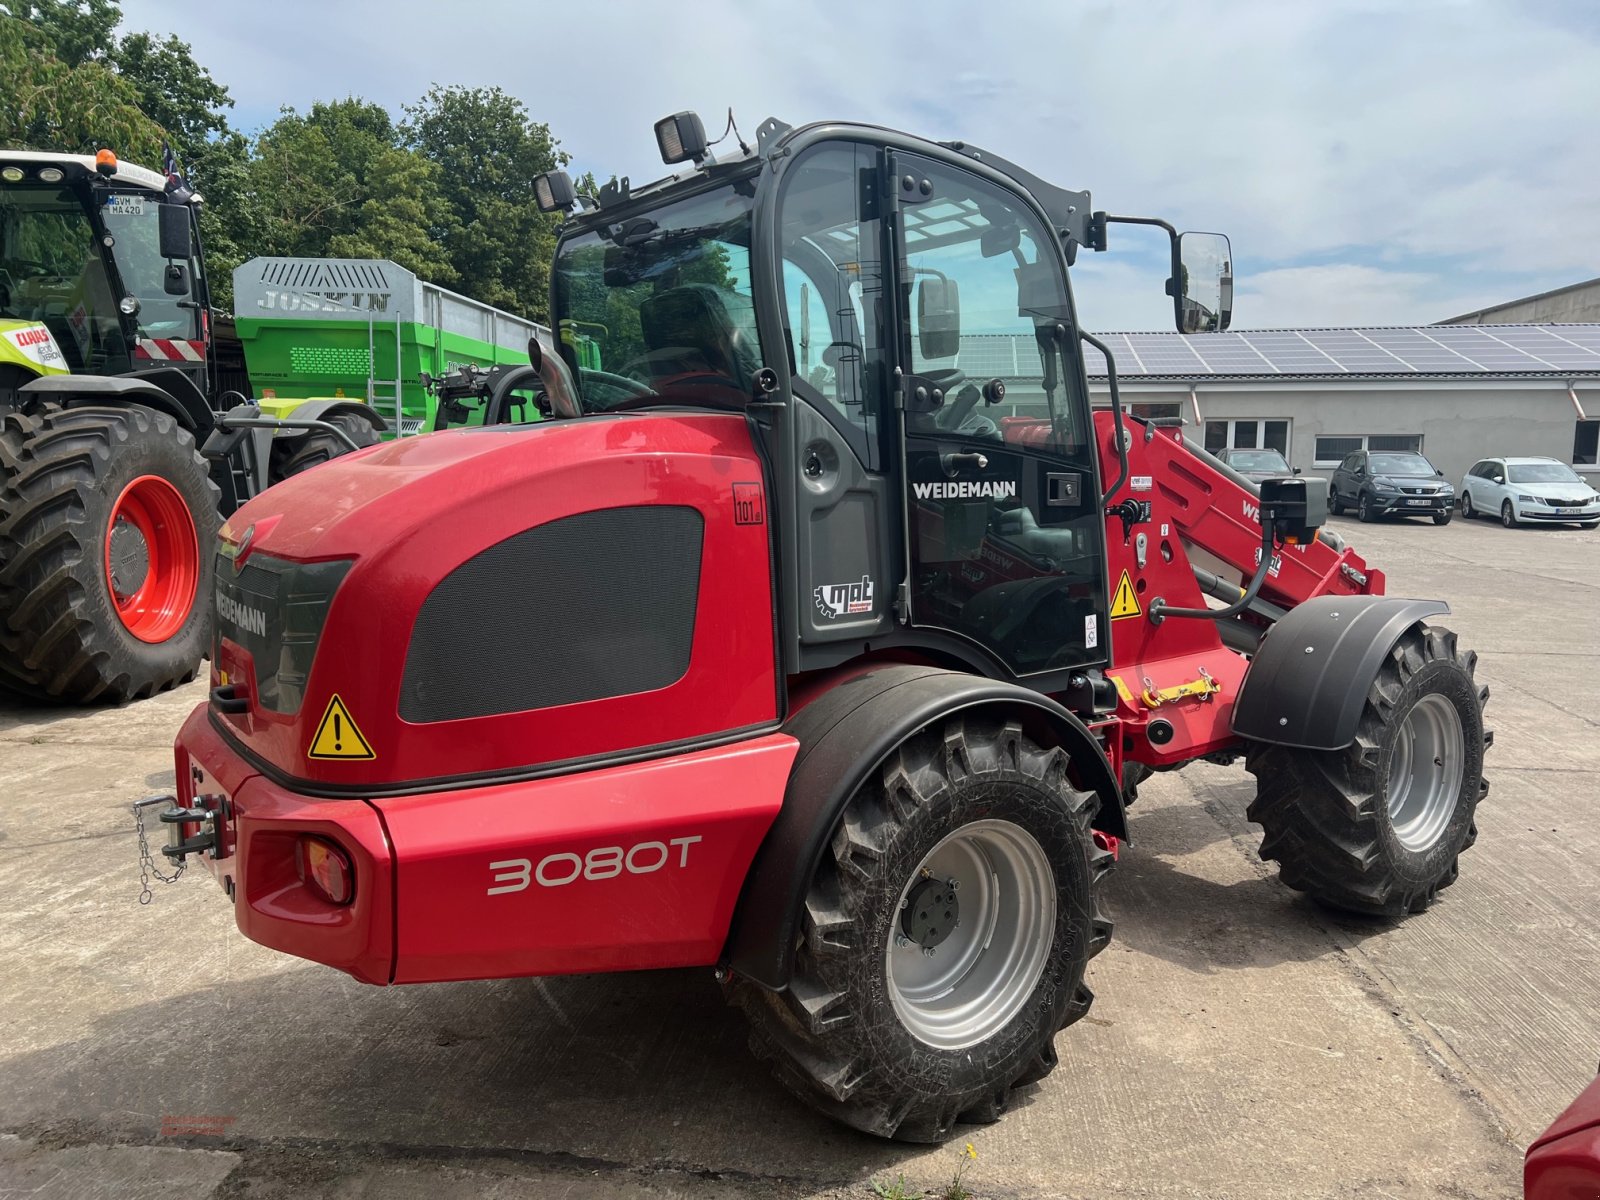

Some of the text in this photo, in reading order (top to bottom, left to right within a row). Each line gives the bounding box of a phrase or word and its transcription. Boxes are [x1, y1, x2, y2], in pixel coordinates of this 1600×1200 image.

[114, 197, 131, 206] GVM
[124, 206, 141, 215] 420
[257, 290, 391, 313] JOSKIN
[15, 328, 50, 347] CLAAS
[912, 481, 1016, 499] WEIDEMANN
[737, 501, 754, 521] 101
[216, 589, 266, 638] WEIDEMANN
[487, 835, 702, 896] 3080T
